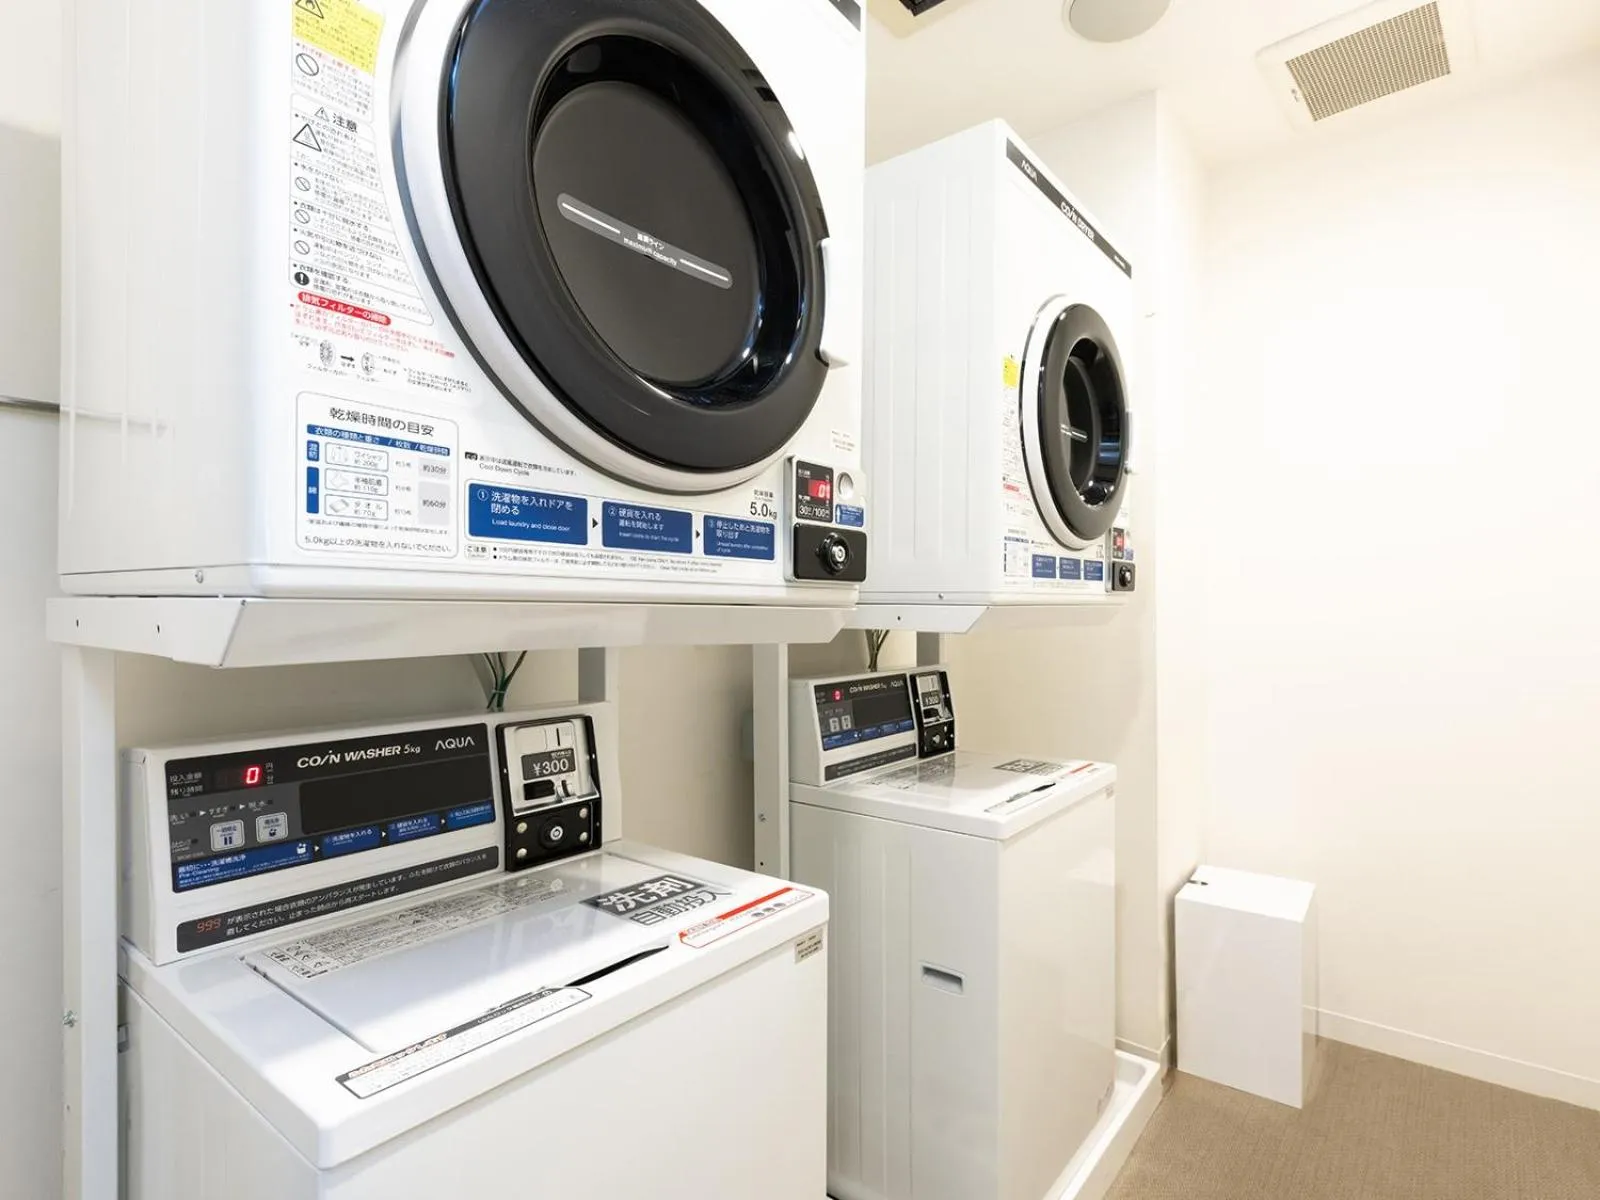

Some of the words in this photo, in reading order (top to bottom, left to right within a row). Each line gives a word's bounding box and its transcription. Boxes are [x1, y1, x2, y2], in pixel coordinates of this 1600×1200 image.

[329, 407, 435, 437] 乾燥時間の目安
[491, 490, 573, 511] 洗濯物を入れドアを
[491, 504, 520, 515] 閉める
[344, 745, 402, 762] WASHER
[403, 743, 421, 754] 5kg
[435, 736, 475, 751] AQUA
[532, 758, 569, 777] ¥300
[197, 918, 221, 933] 999
